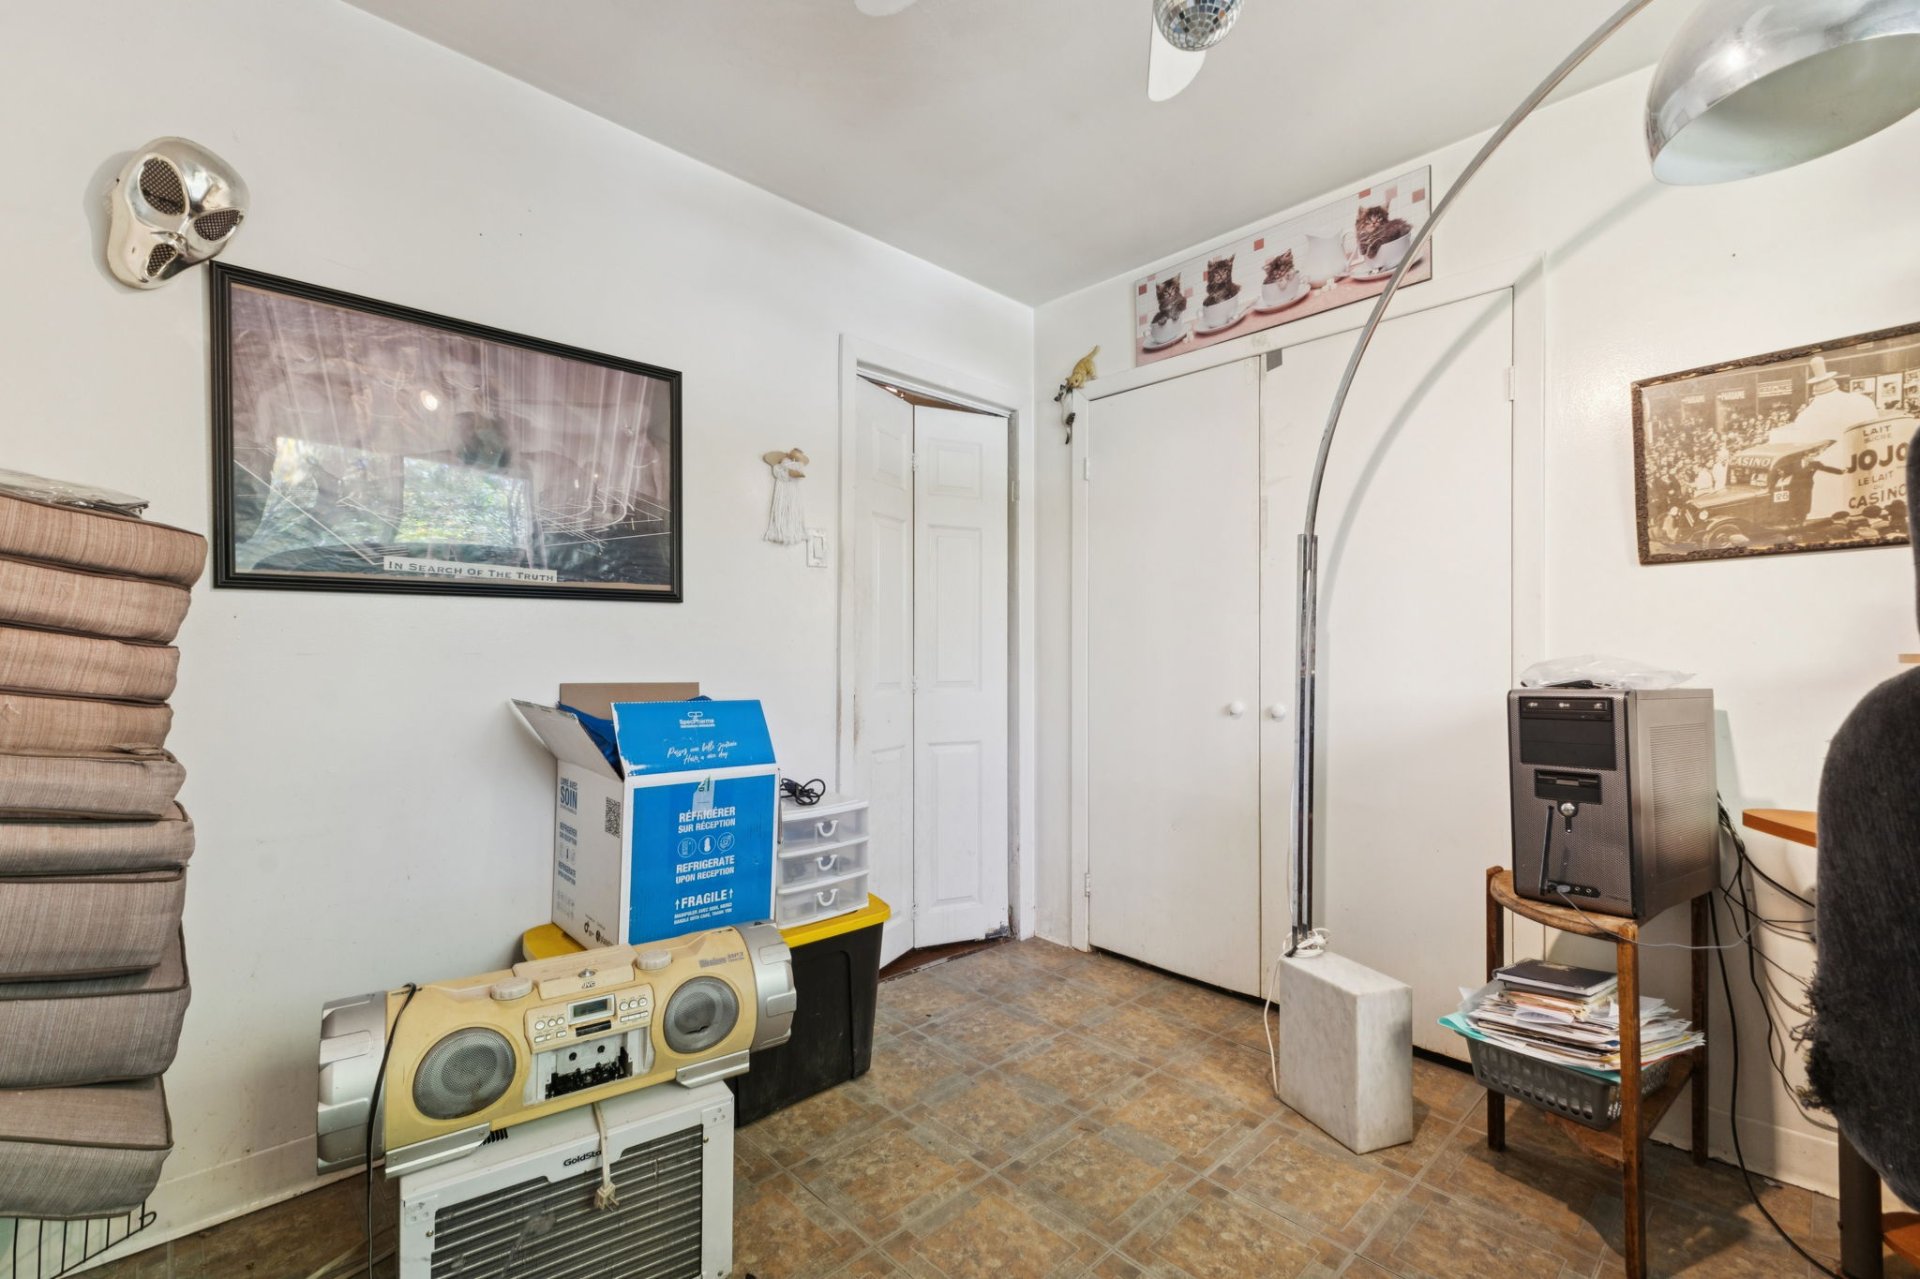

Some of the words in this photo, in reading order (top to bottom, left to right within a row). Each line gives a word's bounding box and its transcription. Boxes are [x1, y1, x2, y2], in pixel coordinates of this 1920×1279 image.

[1862, 425, 1891, 437] LAIT
[1846, 441, 1909, 474] JOJO
[1858, 477, 1870, 487] LE
[1872, 470, 1894, 483] LAIT
[516, 571, 554, 582] TRUTH
[560, 785, 577, 809] SOIN
[679, 806, 736, 823] RÉFRIGÉRER
[678, 823, 694, 834] SUR
[695, 818, 736, 831] RÉCEPTION
[676, 854, 735, 874] REFRIGERATE
[675, 873, 696, 884] UPON
[697, 866, 735, 880] RECEPTION
[681, 889, 728, 909] FRAGILE
[581, 981, 595, 989] JVC
[563, 1150, 602, 1166] GoldSta
